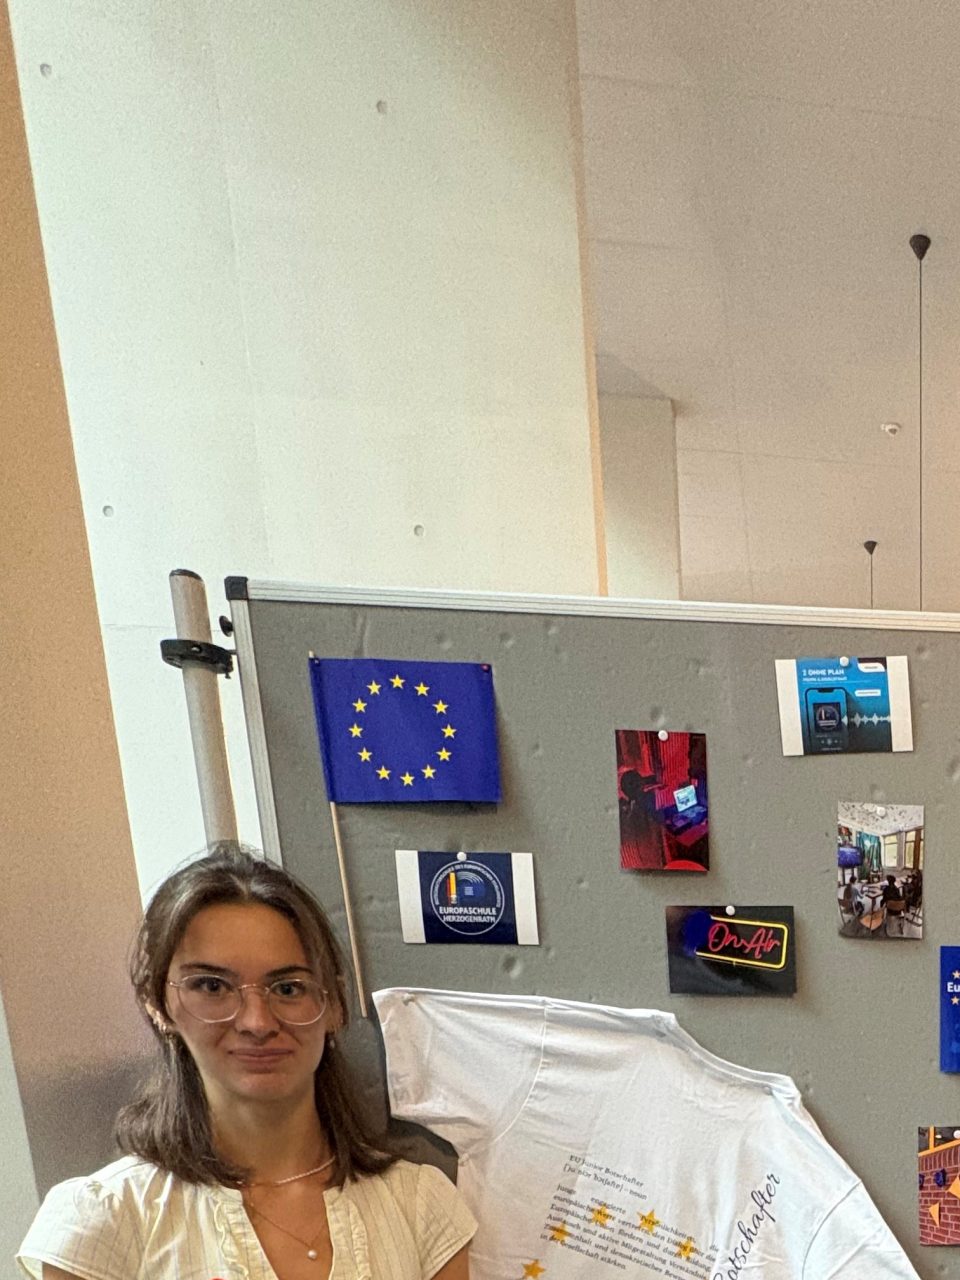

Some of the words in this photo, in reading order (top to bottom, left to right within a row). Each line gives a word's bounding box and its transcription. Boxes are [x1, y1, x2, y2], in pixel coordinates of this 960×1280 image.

[439, 906, 497, 916] EUROPASCHULE
[442, 915, 496, 923] HERZOGENRATH
[604, 1168, 643, 1186] Botschafter
